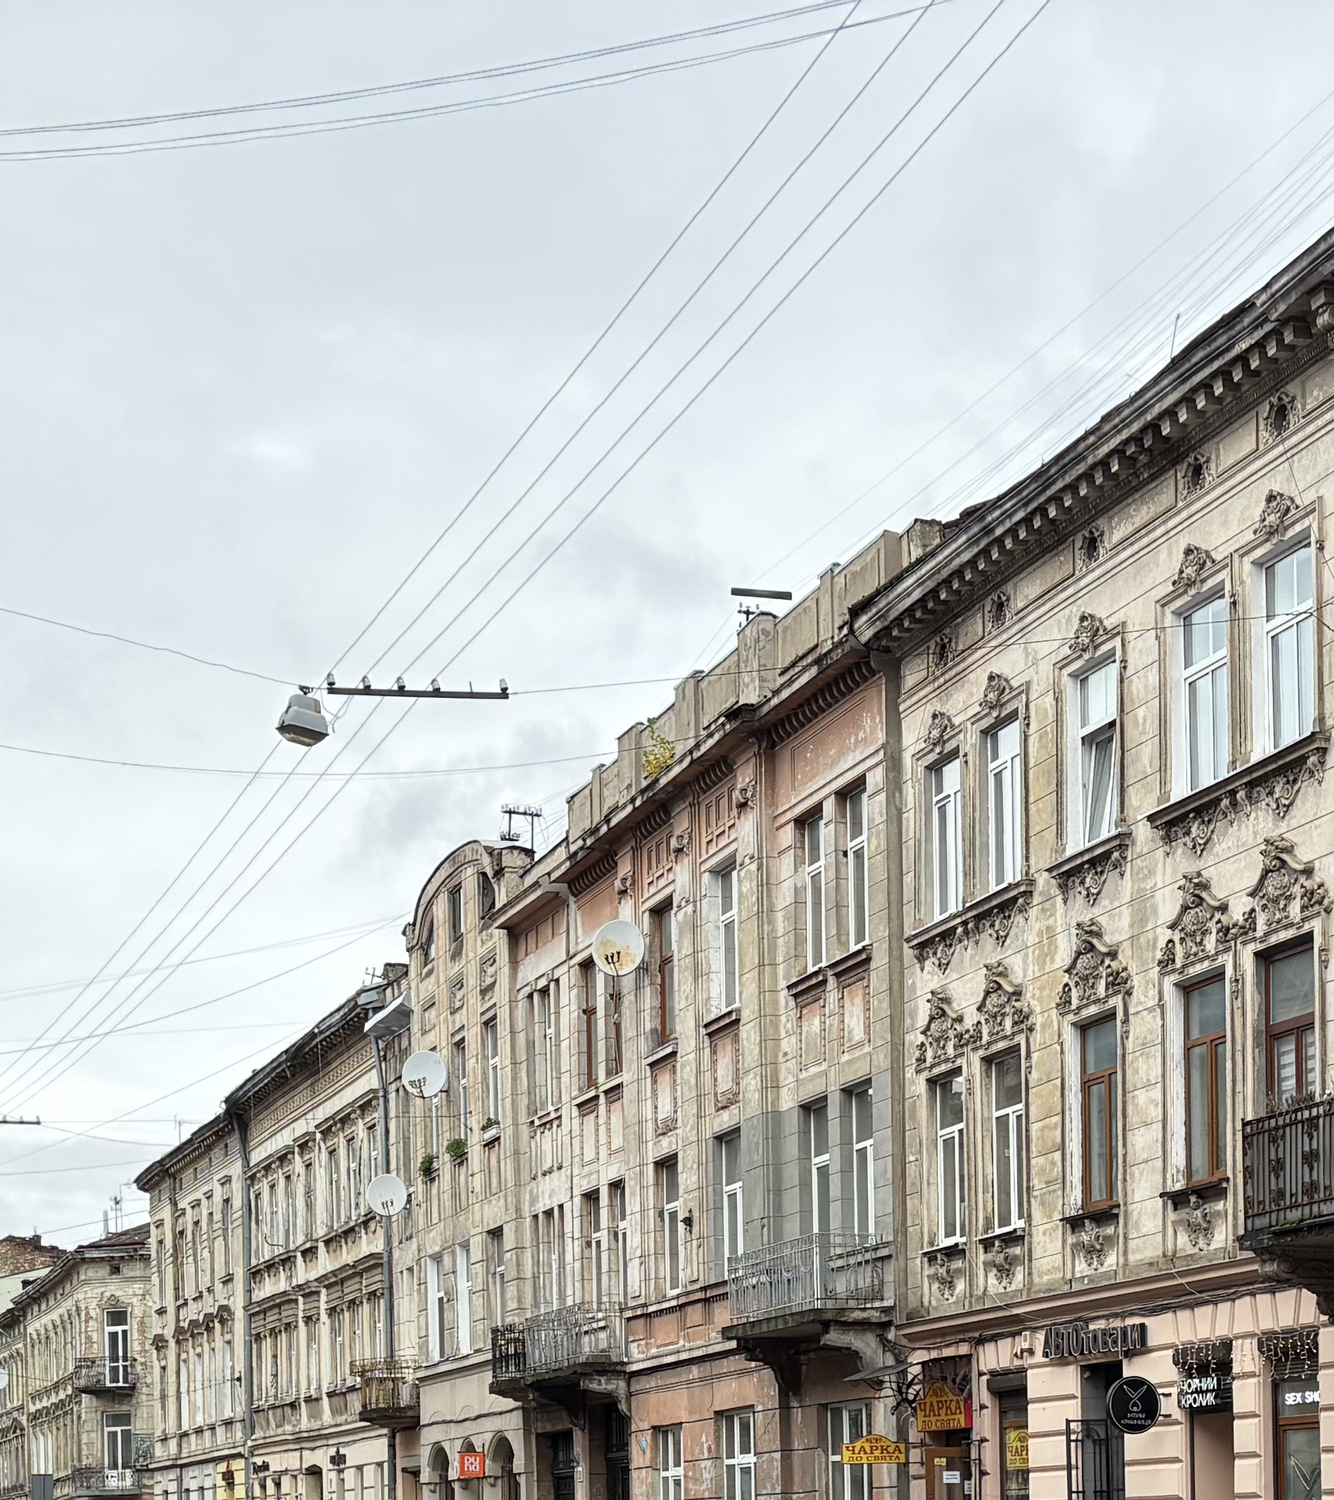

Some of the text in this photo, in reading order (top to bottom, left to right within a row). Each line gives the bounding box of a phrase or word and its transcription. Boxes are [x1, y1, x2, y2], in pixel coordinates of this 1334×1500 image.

[1181, 1393, 1216, 1407] КРОЛИК
[1284, 1392, 1302, 1405] SEX
[918, 1400, 963, 1418] ЧАРКА
[921, 1421, 933, 1430] ДО
[844, 1445, 903, 1455] ЧАРКА
